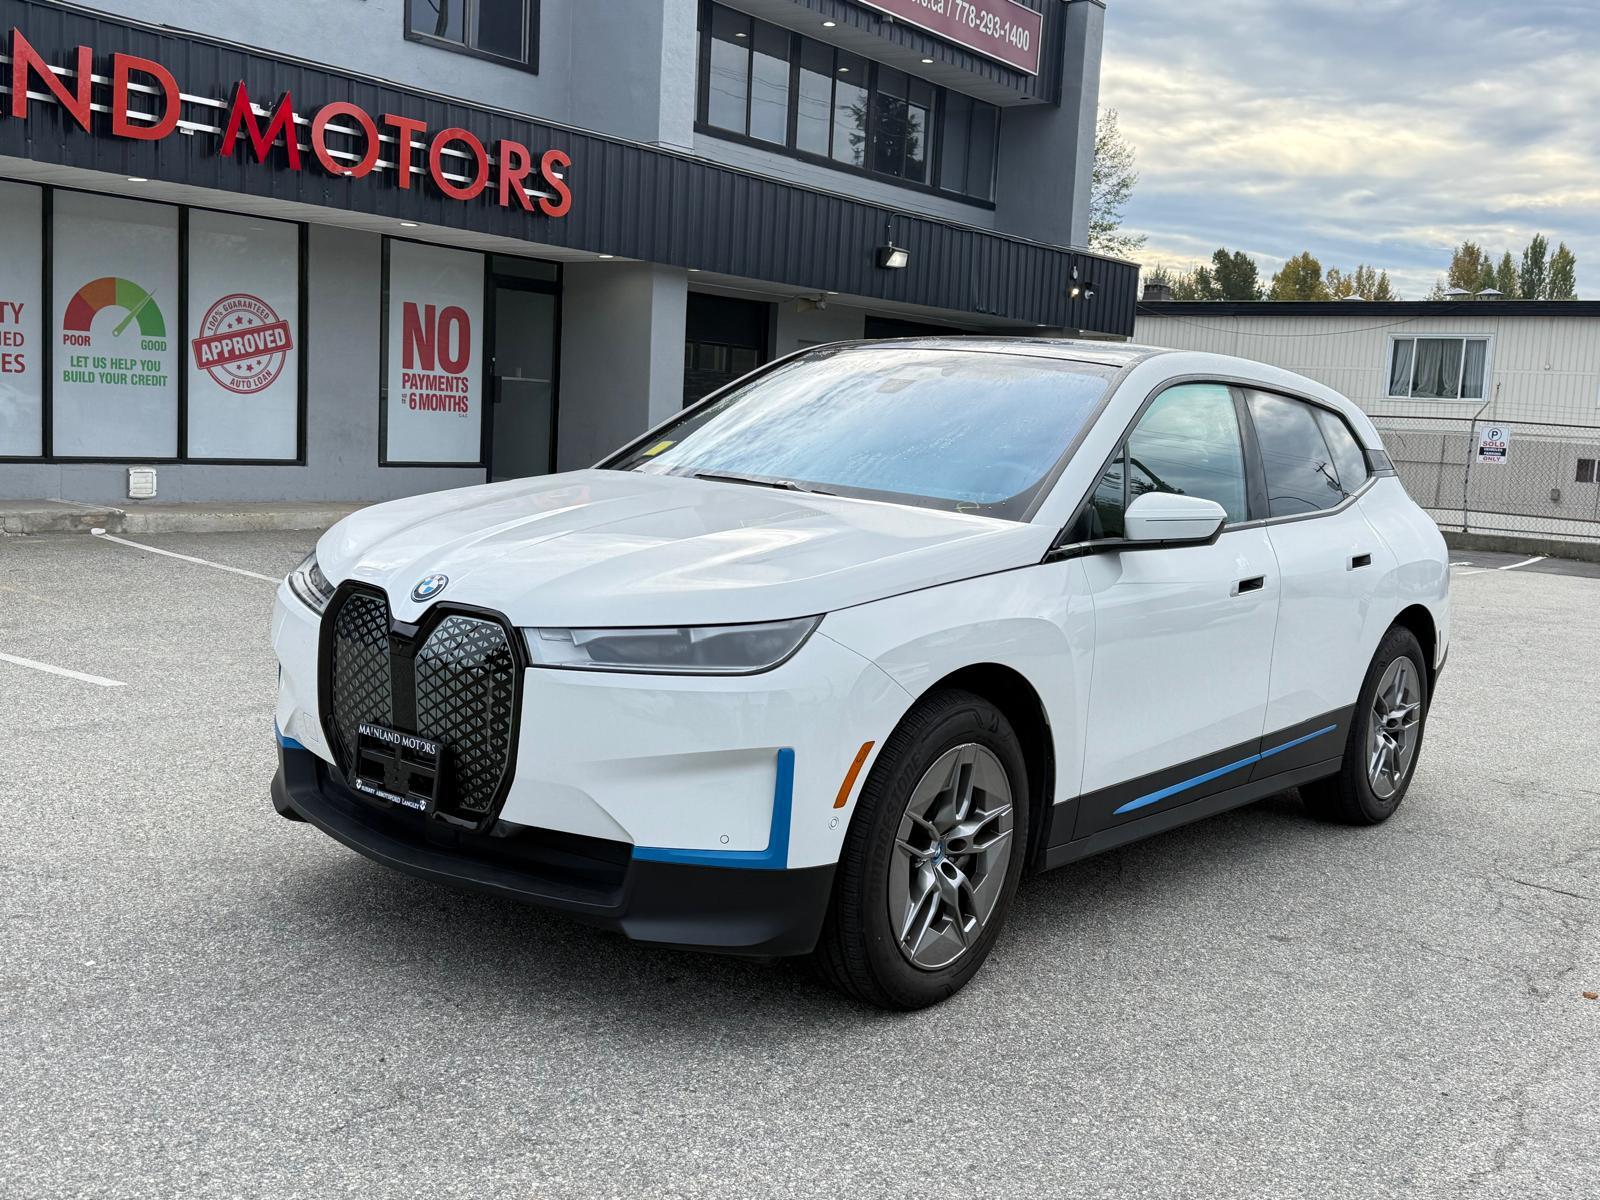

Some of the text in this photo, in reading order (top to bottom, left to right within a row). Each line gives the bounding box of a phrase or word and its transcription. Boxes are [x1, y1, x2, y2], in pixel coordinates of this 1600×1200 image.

[955, 0, 1030, 51] 778-293-1400
[0, 26, 573, 217] ND MOTORS
[207, 299, 270, 331] 100% GUARANTEED
[63, 333, 91, 347] POOR
[141, 339, 167, 352] GOOD
[201, 327, 286, 363] APPROVED
[403, 303, 470, 375] NO
[1, 352, 26, 374] ES
[70, 355, 161, 372] LET US HELP YOU
[63, 370, 168, 387] BUILD YOUR CREDIT
[229, 369, 273, 389] AUTO LOAN
[402, 372, 469, 393] PAYMENTS
[409, 392, 417, 410] 6
[418, 393, 469, 413] MONTHS
[359, 724, 435, 754] MAINLAND MOTORS
